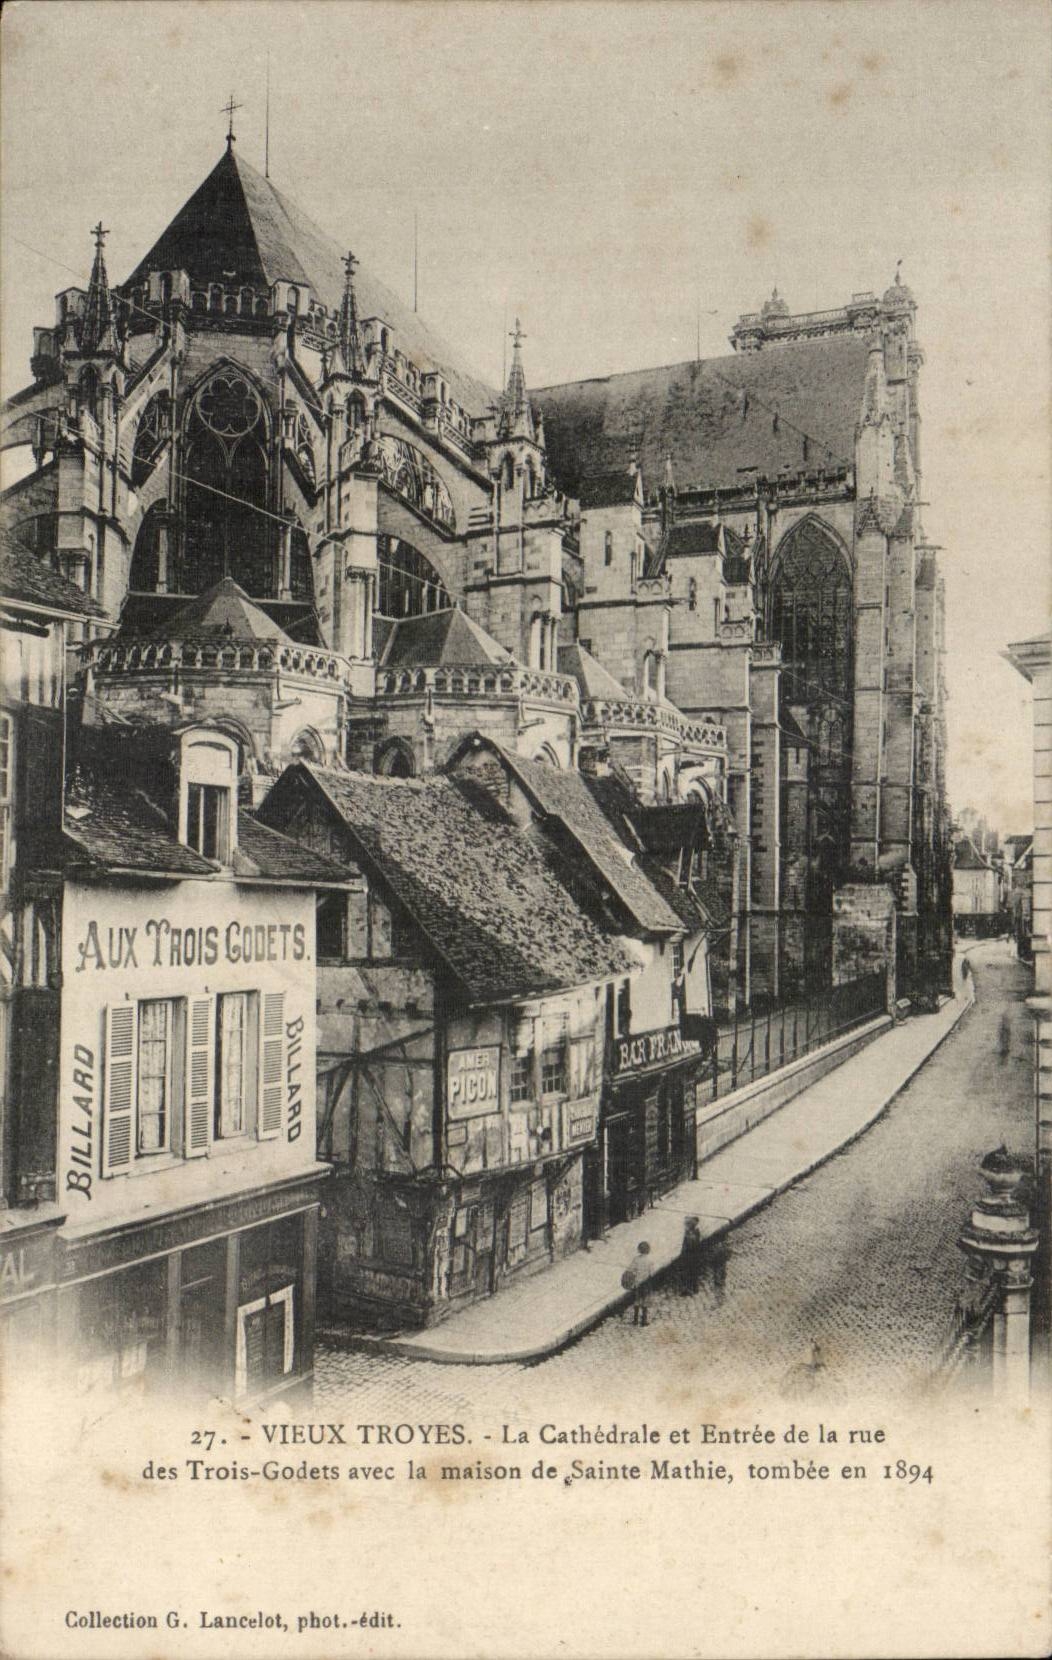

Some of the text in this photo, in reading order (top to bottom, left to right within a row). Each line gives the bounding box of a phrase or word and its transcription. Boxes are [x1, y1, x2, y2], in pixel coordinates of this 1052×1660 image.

[76, 920, 138, 973] AUX
[146, 918, 219, 968] TROIS
[66, 1044, 95, 1201] BILLARD
[286, 1016, 303, 1144] BILLARD
[450, 1069, 498, 1104] PICON
